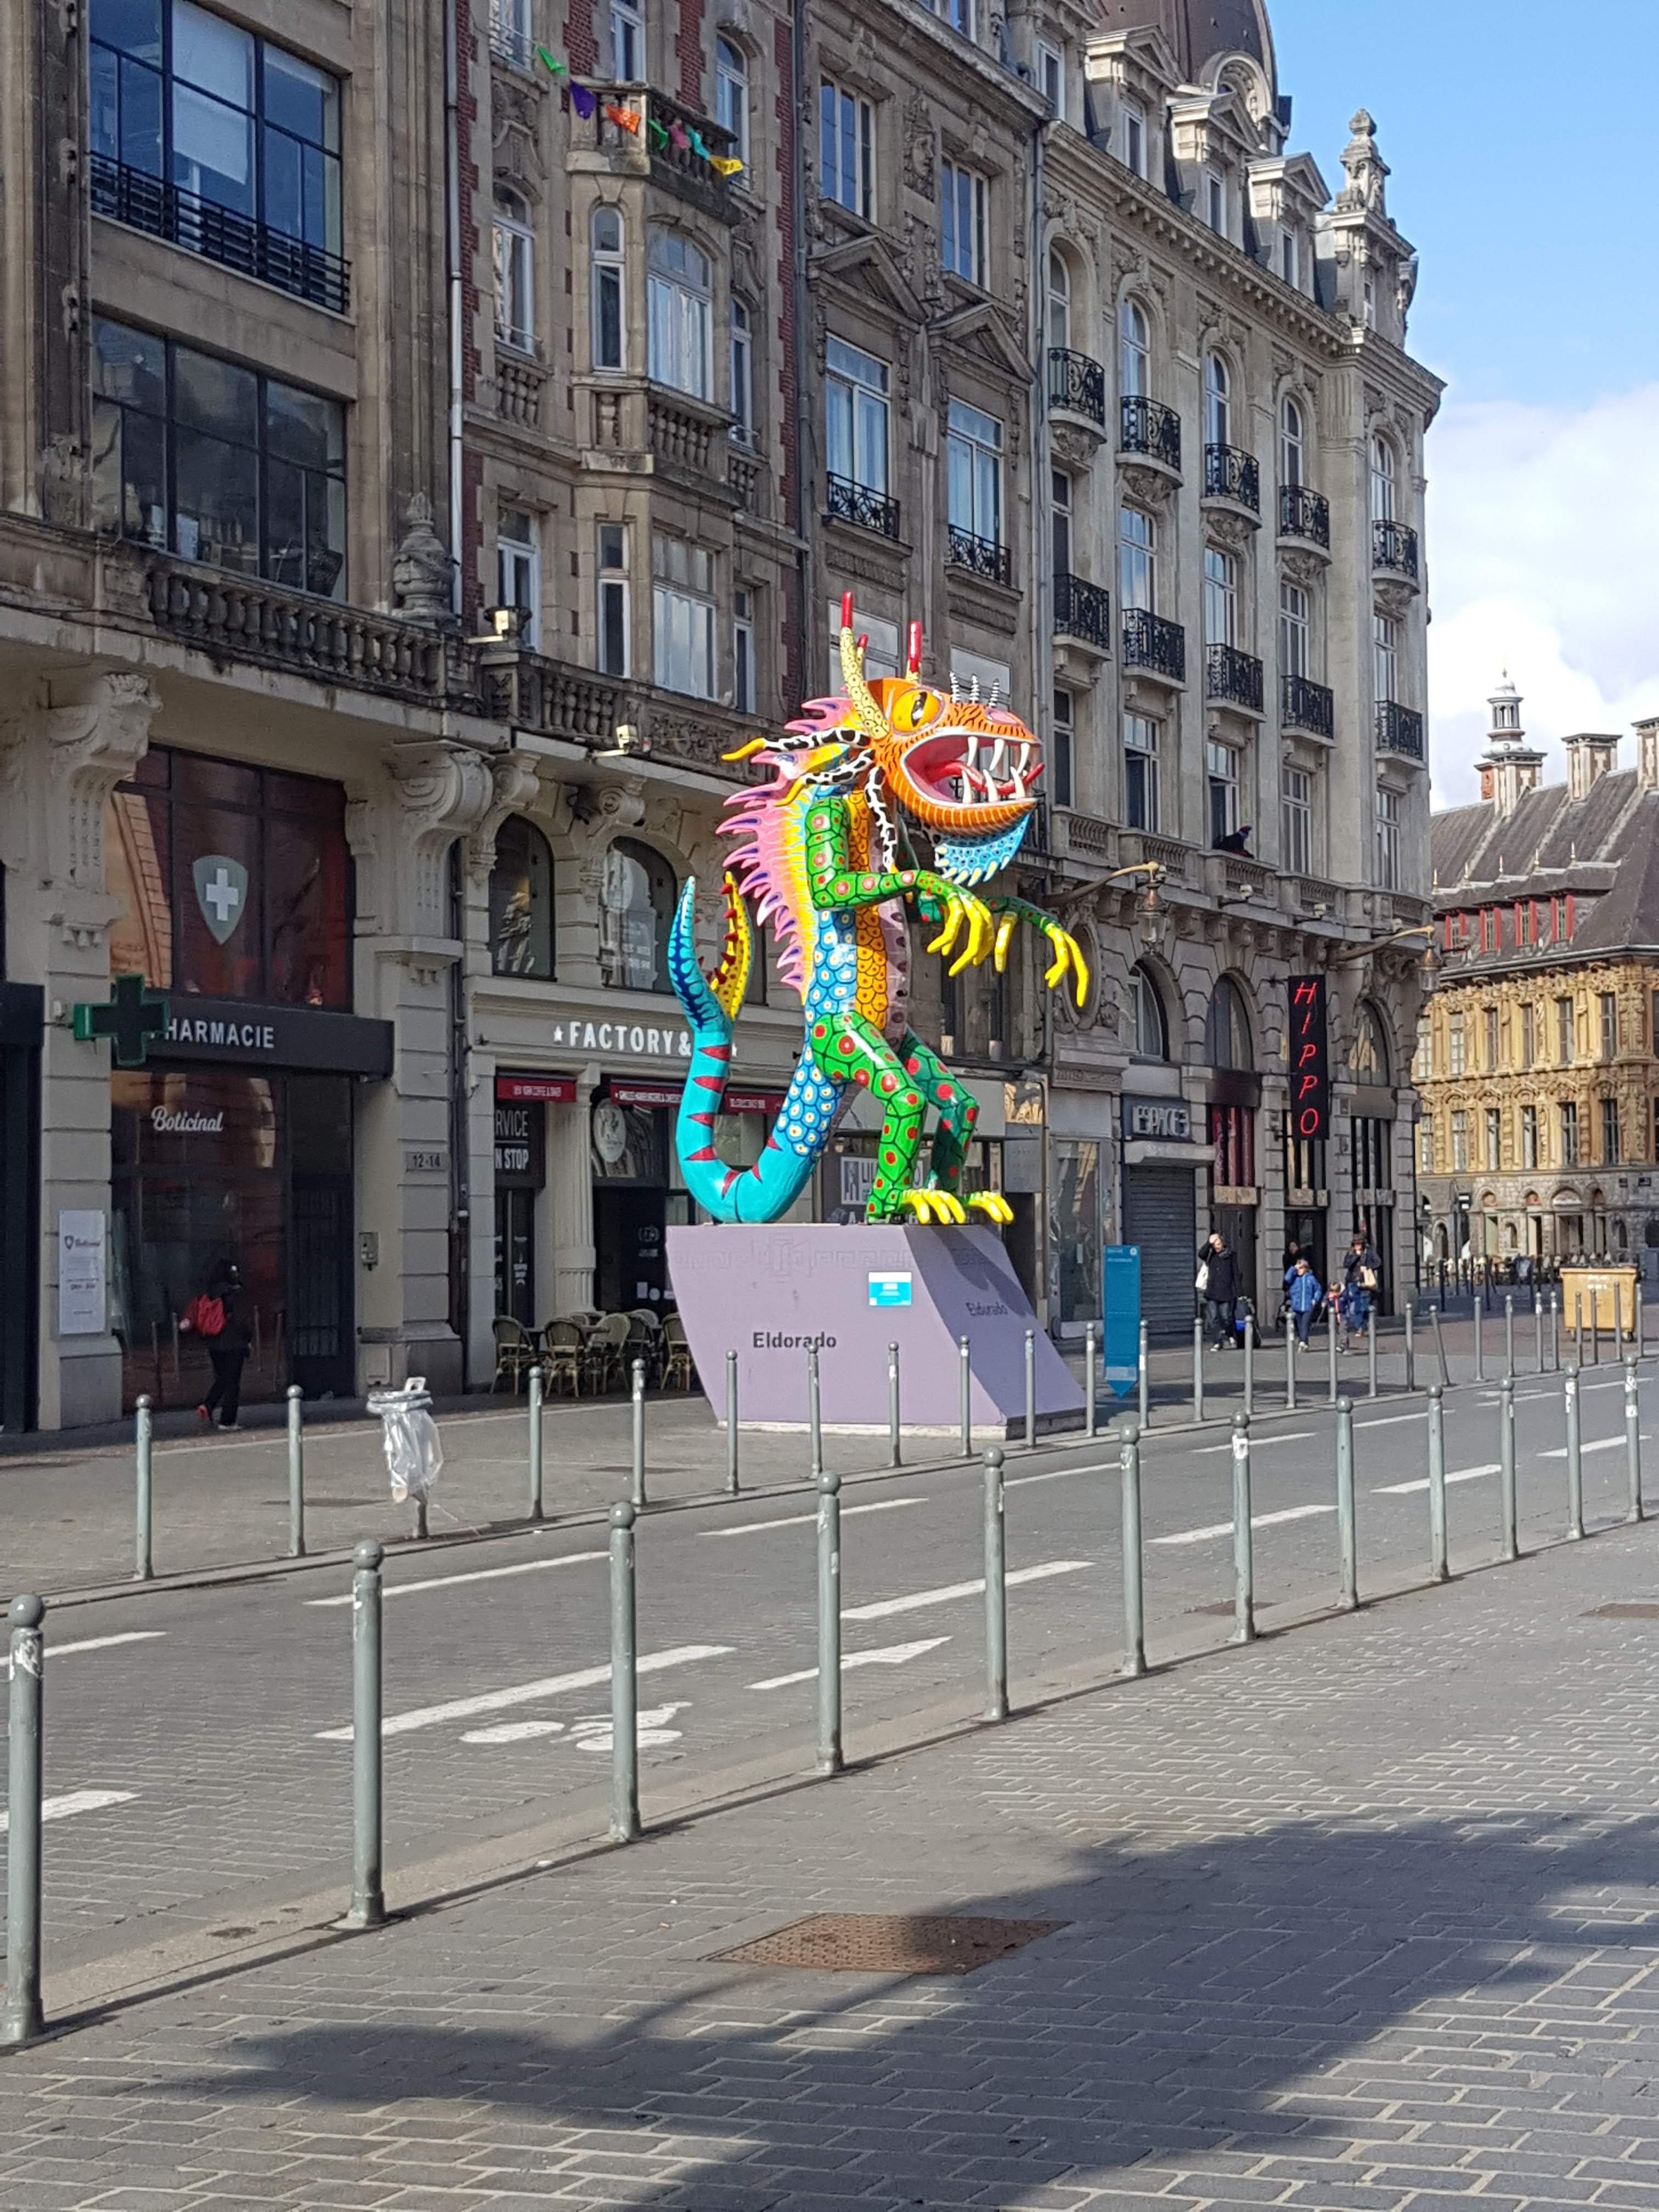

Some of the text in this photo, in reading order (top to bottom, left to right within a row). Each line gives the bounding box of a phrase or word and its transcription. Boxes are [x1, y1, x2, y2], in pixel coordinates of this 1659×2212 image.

[151, 1018, 274, 1048] HARMACIE
[570, 1021, 673, 1054] FACTORY
[1294, 981, 1319, 1135] HIPPO
[151, 1105, 223, 1131] Boticinal
[504, 1148, 529, 1169] STOP
[753, 1331, 837, 1348] Eldorado
